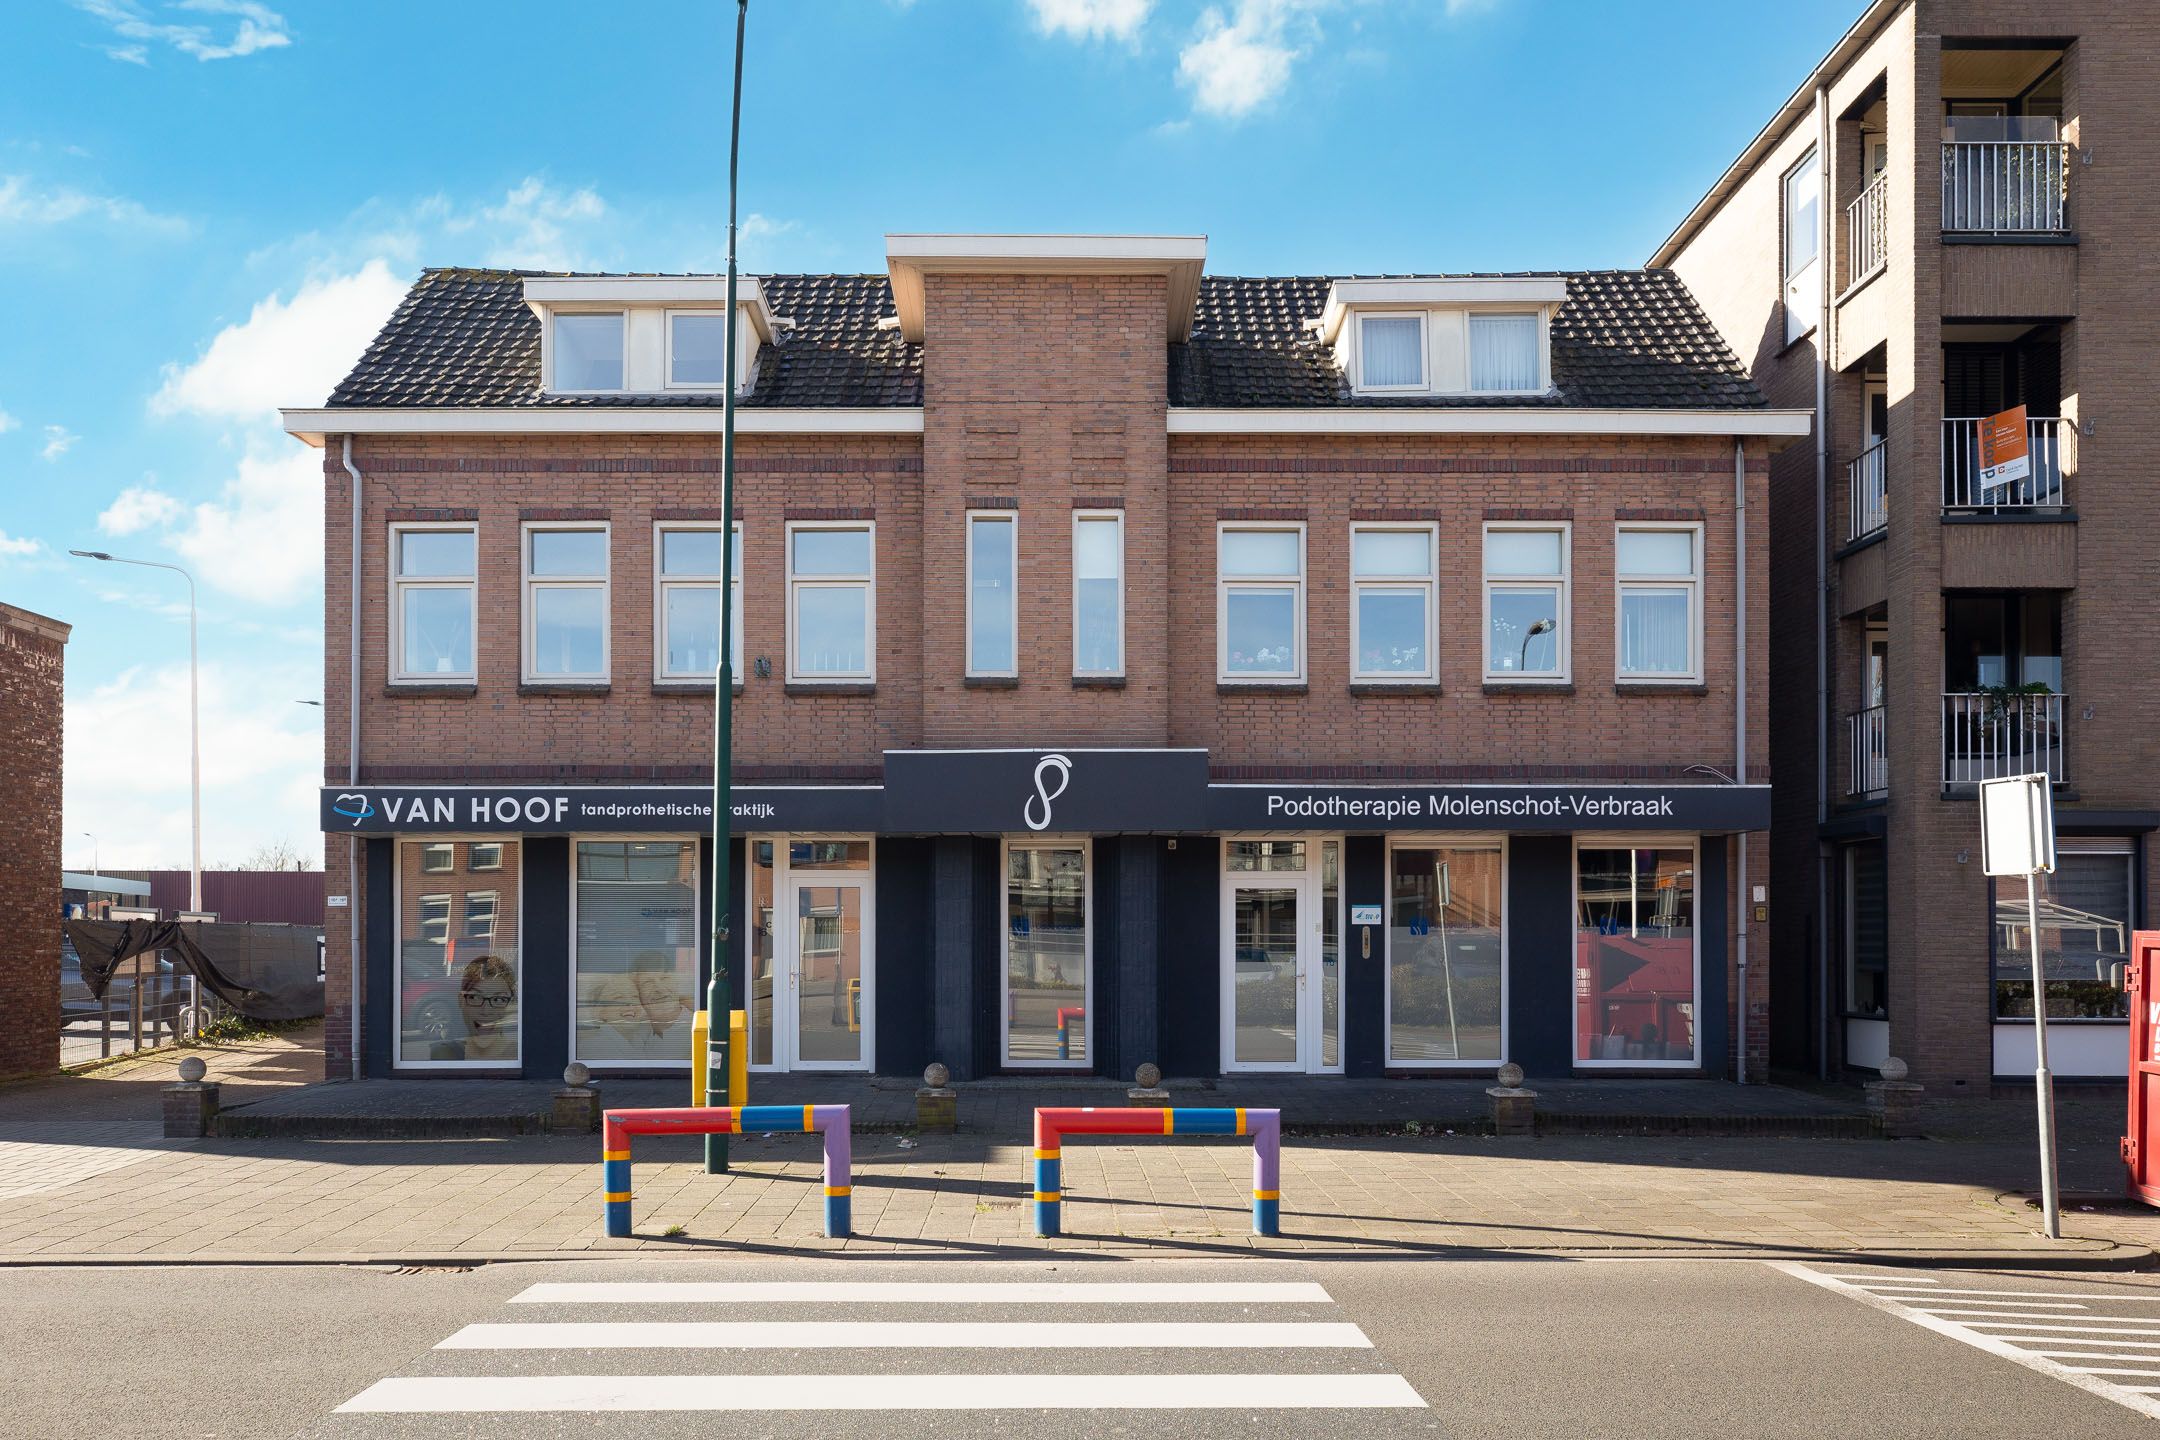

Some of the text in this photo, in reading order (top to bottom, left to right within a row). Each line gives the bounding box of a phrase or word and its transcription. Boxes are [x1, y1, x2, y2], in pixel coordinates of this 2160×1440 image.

[1982, 438, 1996, 479] koop
[381, 796, 775, 823] VAN HOOF tandprothetische aktijk
[1267, 794, 1674, 820] Podotherapie Molenschot-Verbraak
